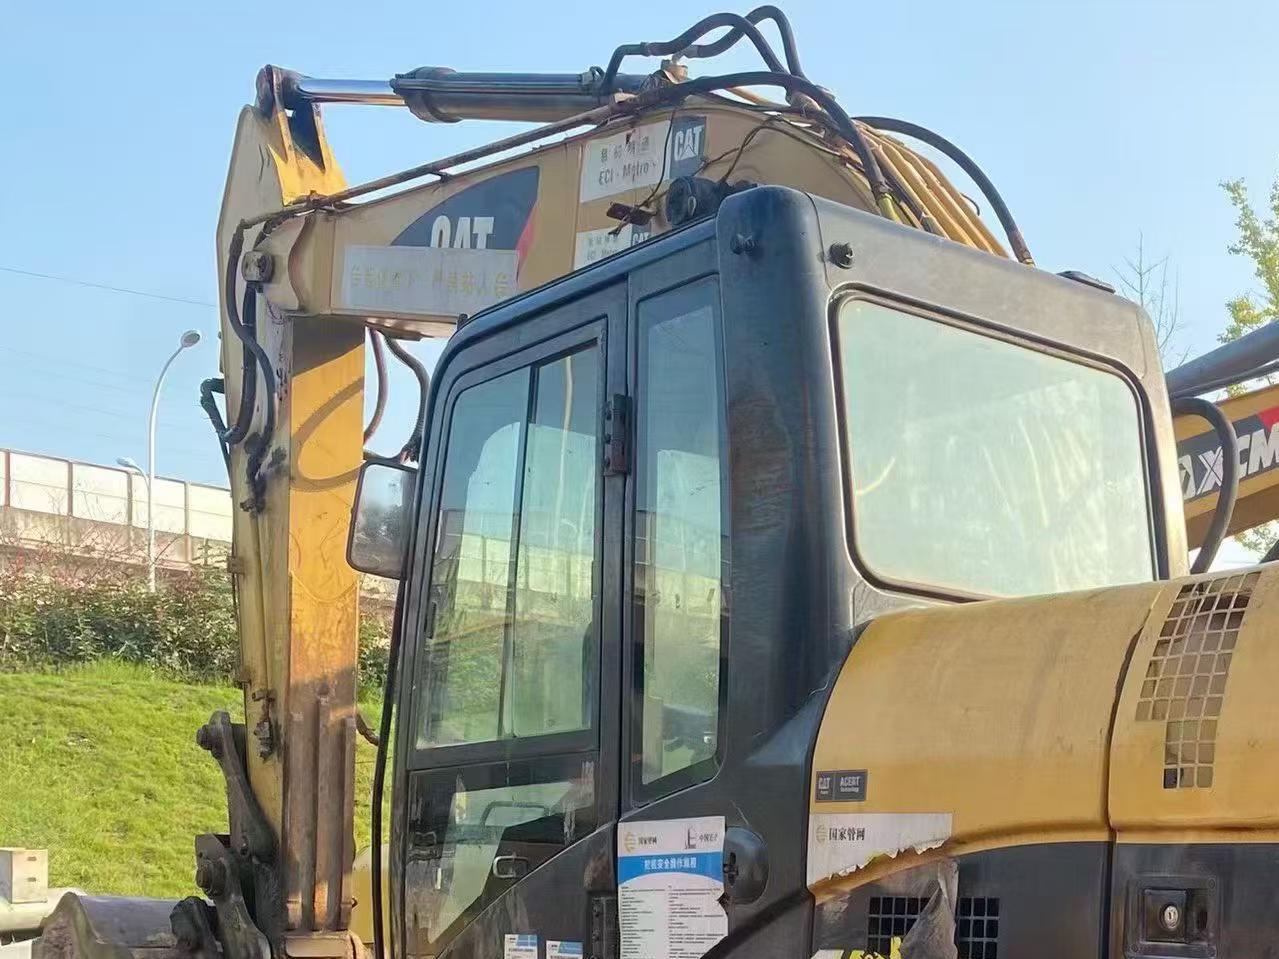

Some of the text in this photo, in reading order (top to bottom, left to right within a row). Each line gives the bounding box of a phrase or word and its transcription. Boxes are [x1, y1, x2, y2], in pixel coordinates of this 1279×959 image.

[674, 125, 704, 162] CAT
[840, 776, 860, 787] ACERT
[829, 827, 865, 841] 国家管网
